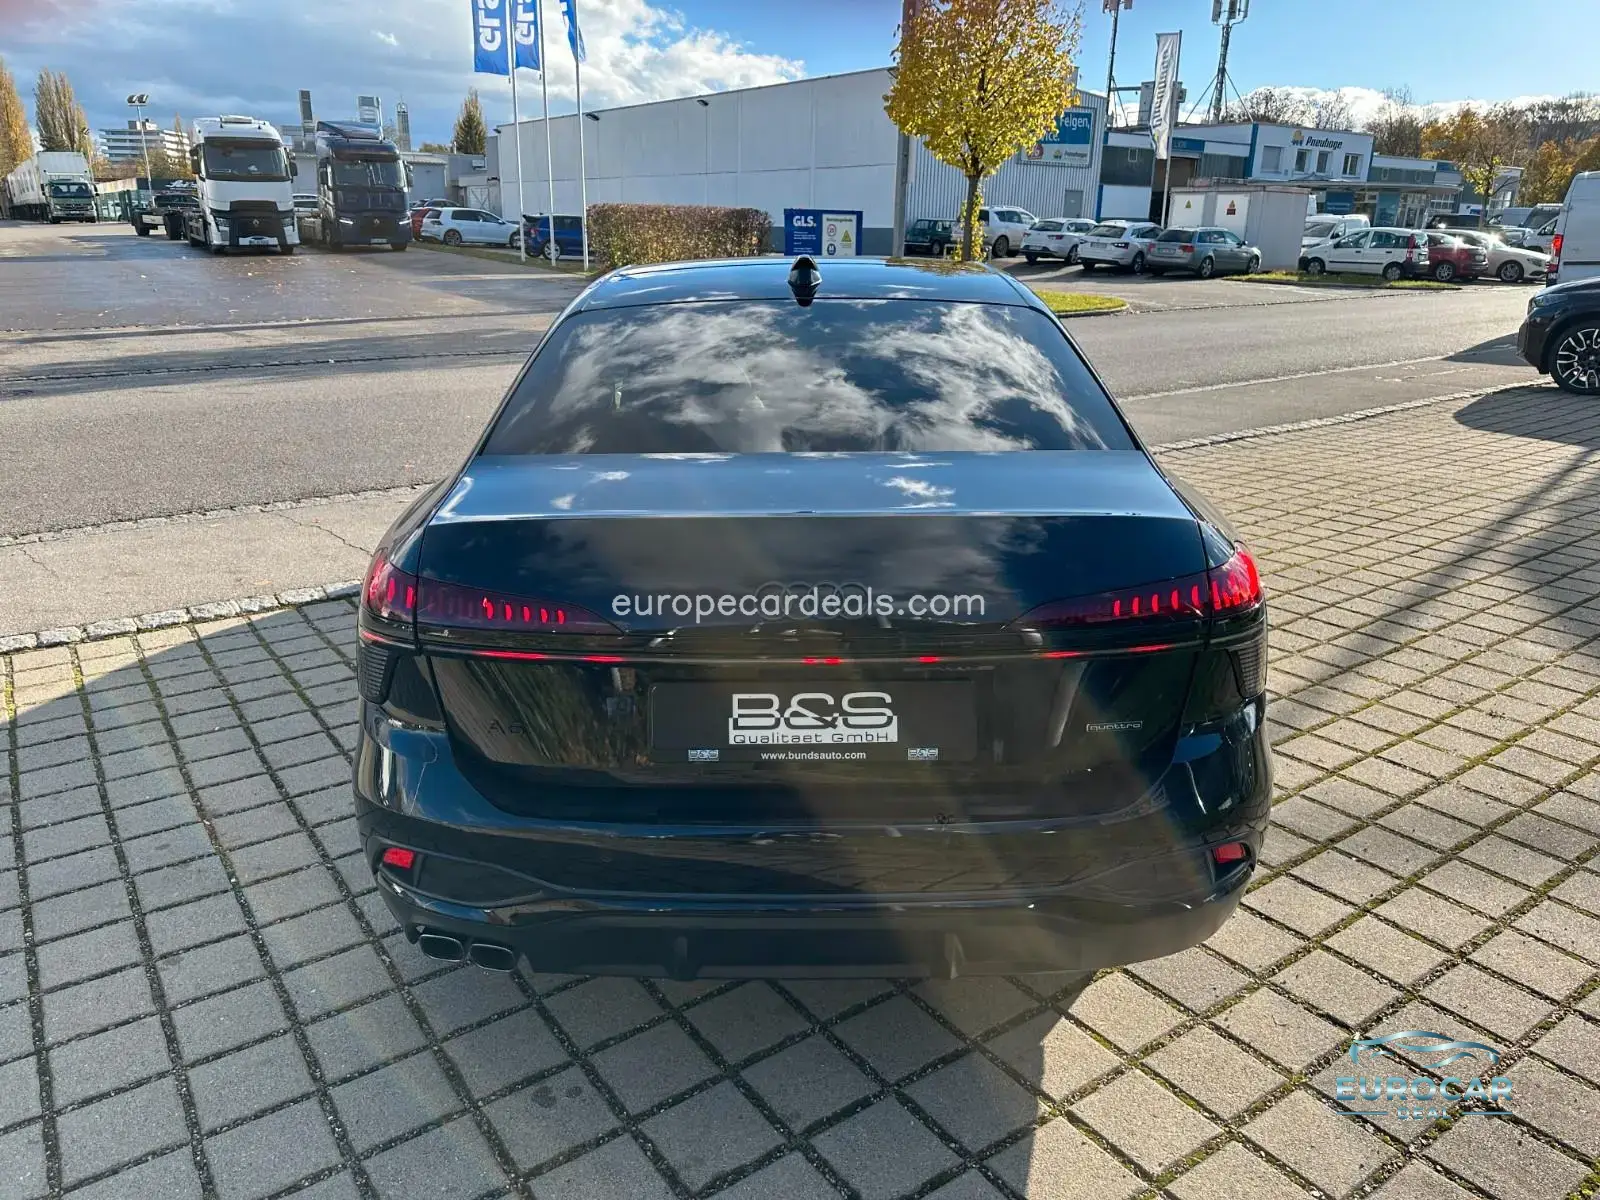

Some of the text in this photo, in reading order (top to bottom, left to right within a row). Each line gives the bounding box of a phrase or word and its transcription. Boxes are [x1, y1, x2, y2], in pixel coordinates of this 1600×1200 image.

[1306, 136, 1343, 150] Pneuhage
[732, 692, 894, 730] B&S
[1089, 722, 1142, 732] quattro
[733, 731, 889, 744] Qualitaet GmbH
[760, 751, 867, 760] www.bundsauto.com
